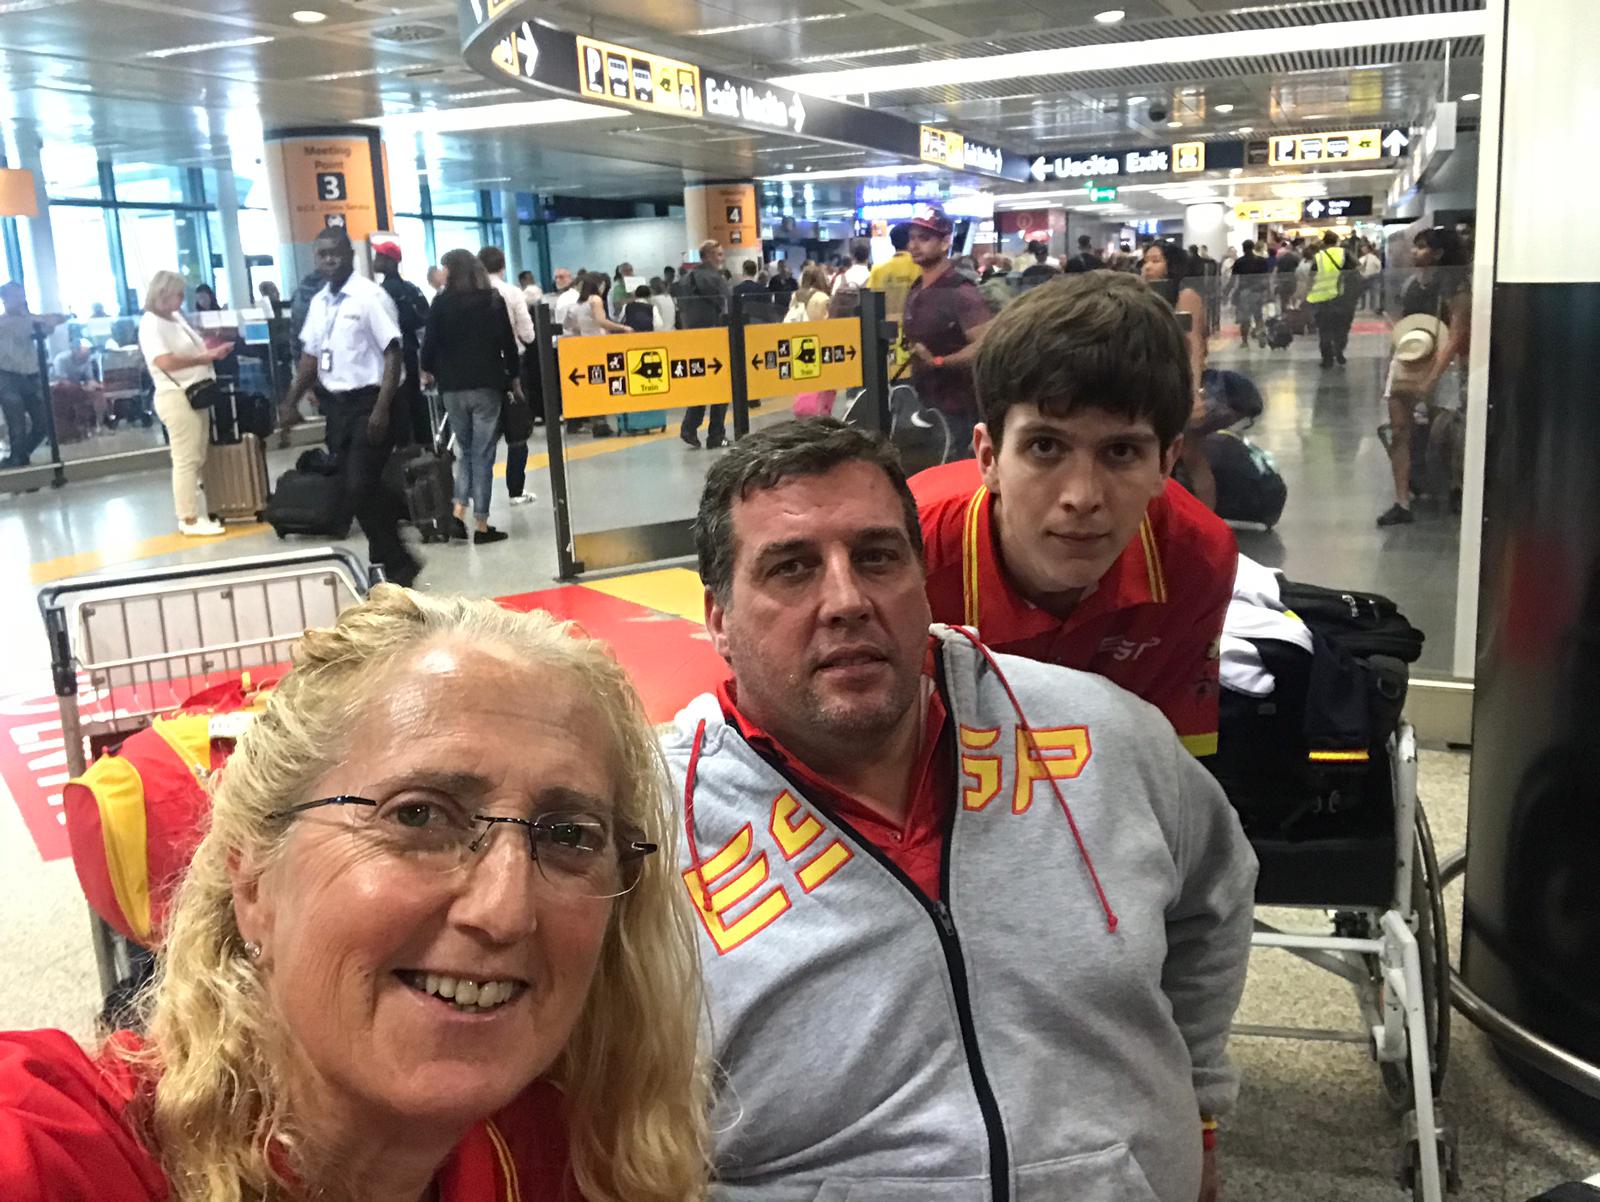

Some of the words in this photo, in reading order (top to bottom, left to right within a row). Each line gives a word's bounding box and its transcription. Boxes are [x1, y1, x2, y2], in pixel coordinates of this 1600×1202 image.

[303, 146, 351, 158] Meeting
[314, 160, 344, 170] Point
[1054, 154, 1119, 178] Uscita
[1126, 150, 1168, 173] Exit
[323, 175, 341, 200] 3
[729, 207, 740, 223] 4
[640, 383, 659, 392] Train
